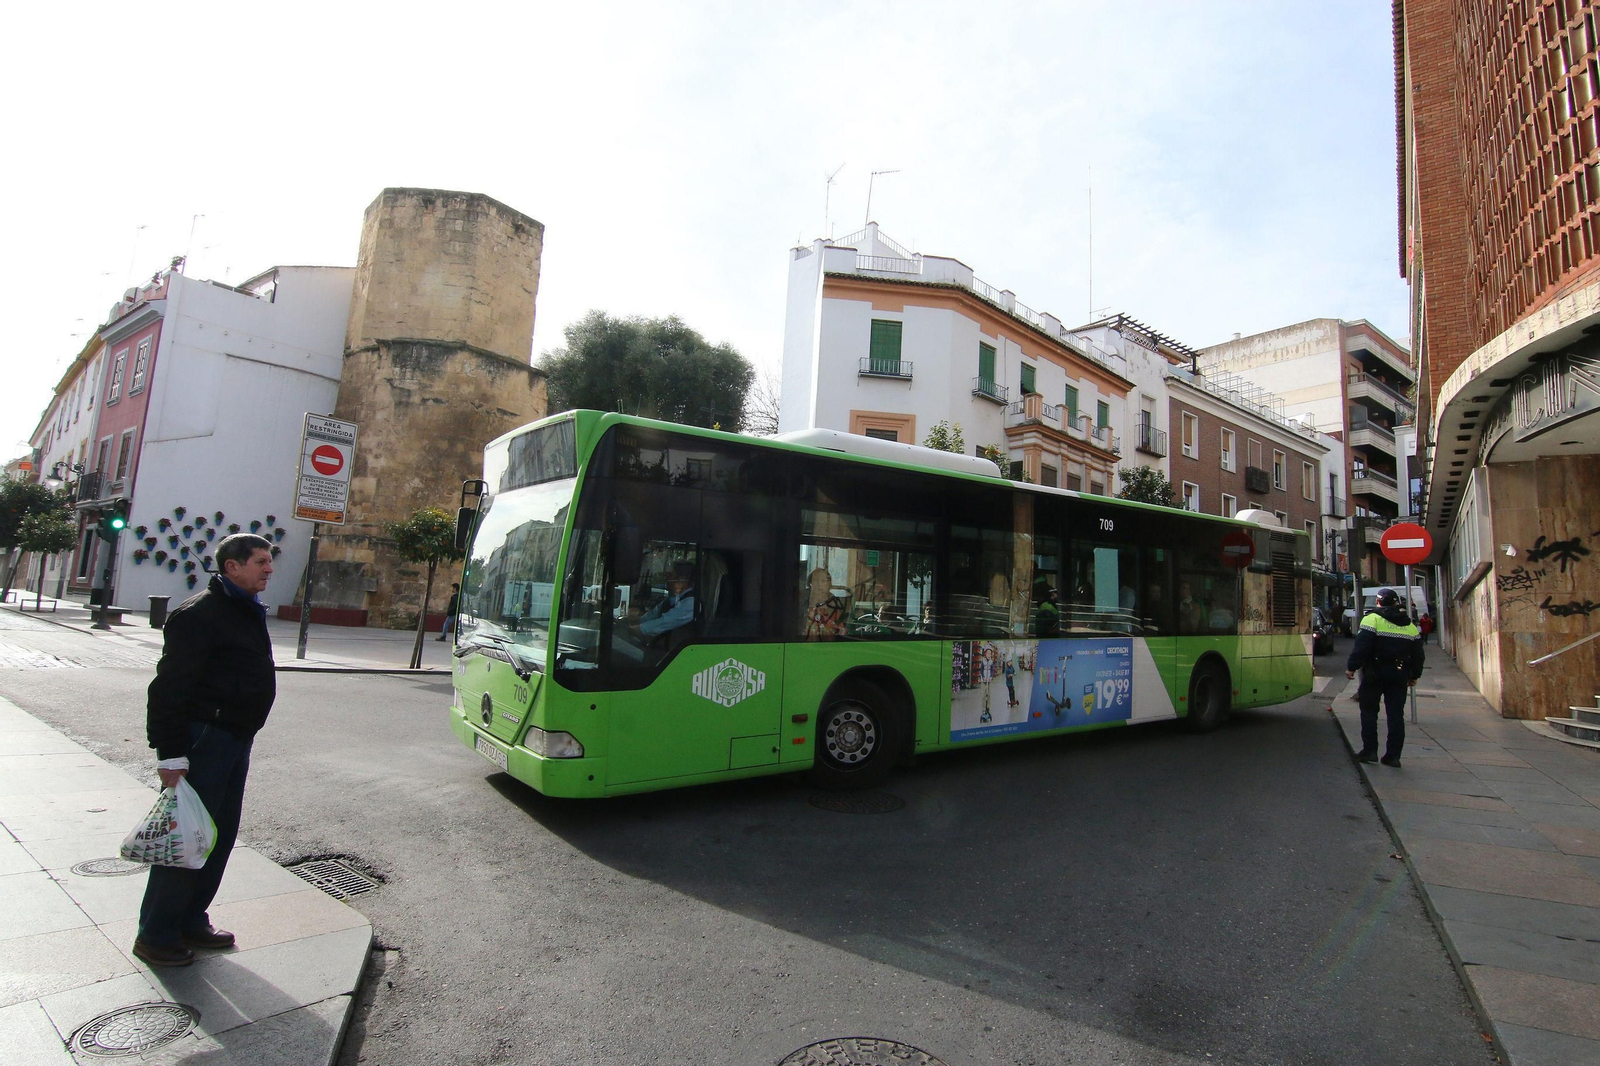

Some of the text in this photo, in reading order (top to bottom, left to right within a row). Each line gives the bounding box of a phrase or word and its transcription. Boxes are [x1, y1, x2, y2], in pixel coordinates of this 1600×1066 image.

[309, 424, 353, 437] RESTRINGIDA
[1099, 518, 1113, 531] 709
[514, 683, 527, 705] 709
